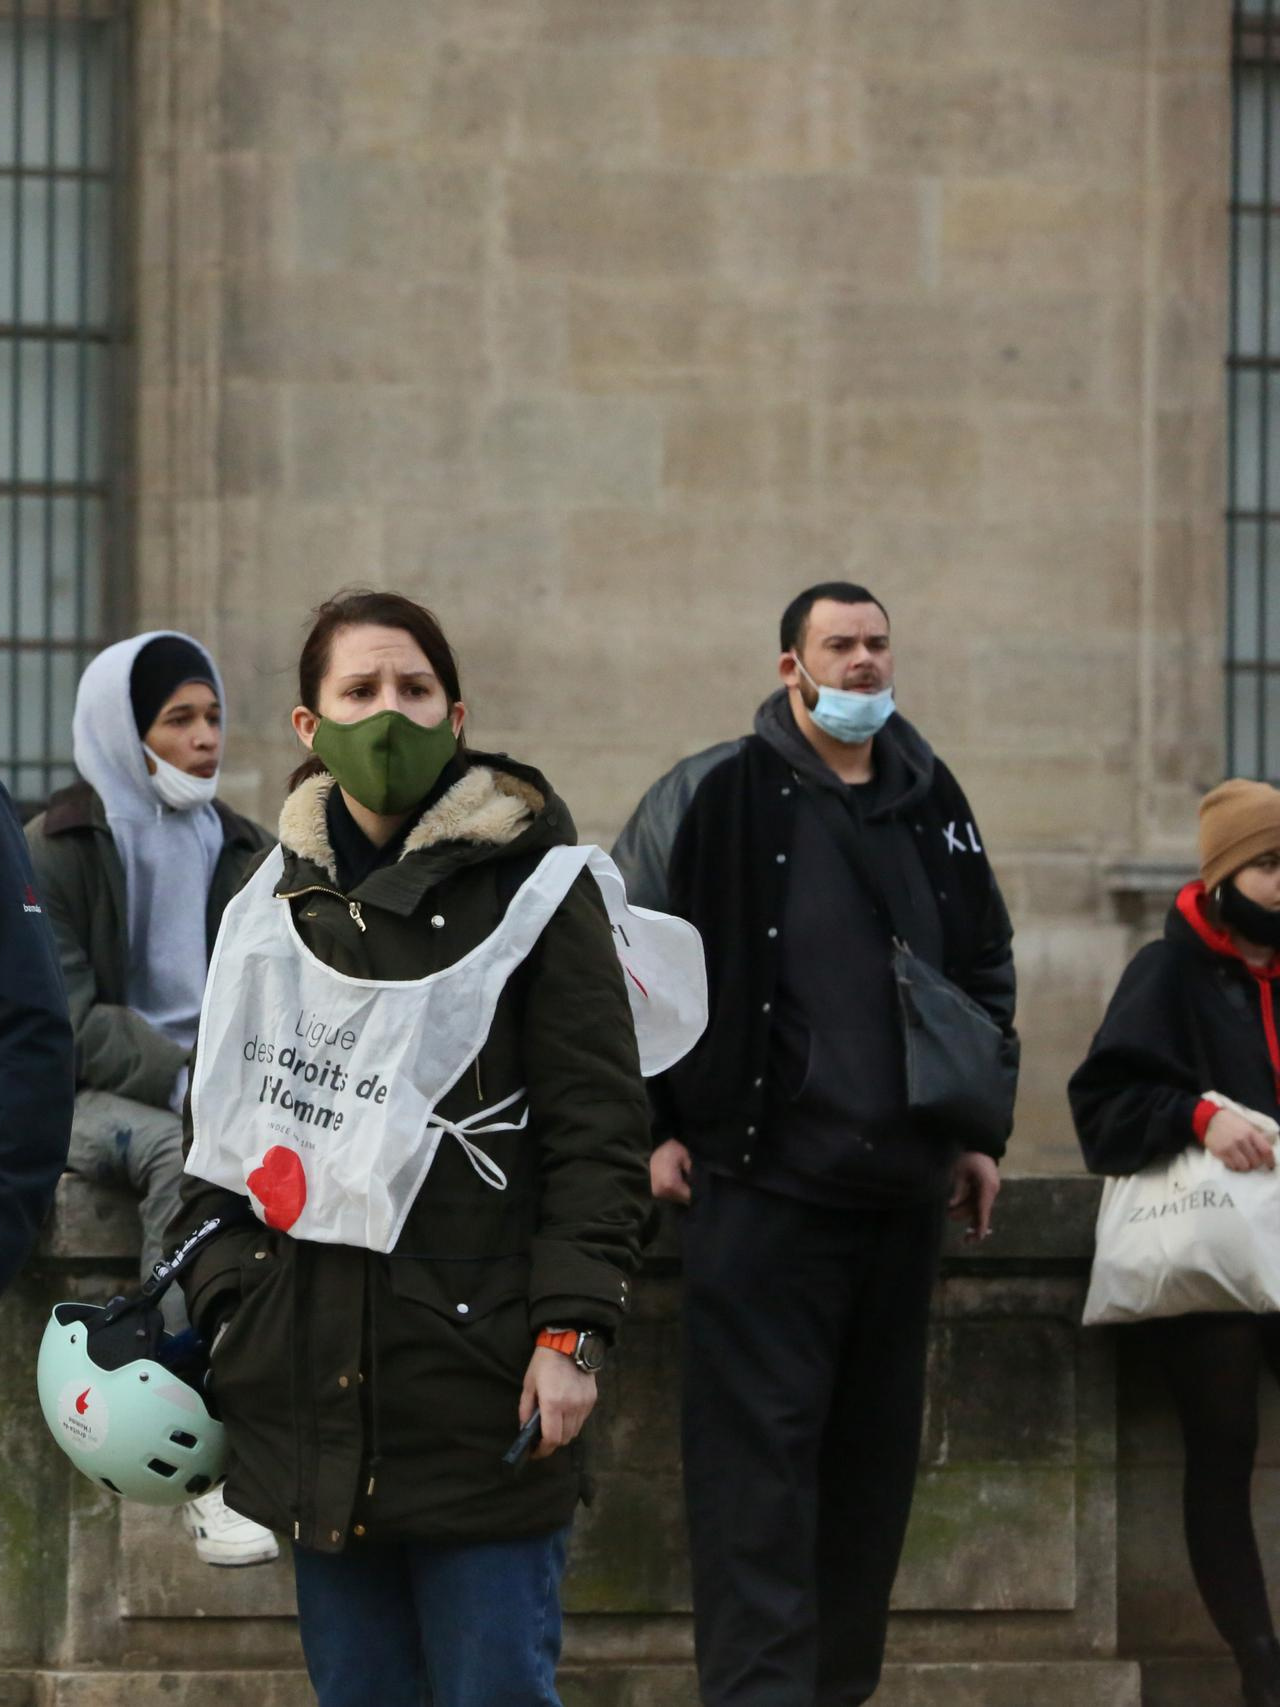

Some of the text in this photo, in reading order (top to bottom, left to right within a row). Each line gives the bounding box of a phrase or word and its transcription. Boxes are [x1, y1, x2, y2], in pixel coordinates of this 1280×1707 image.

[295, 1009, 356, 1050] Ligue
[243, 1034, 388, 1105] des droits de
